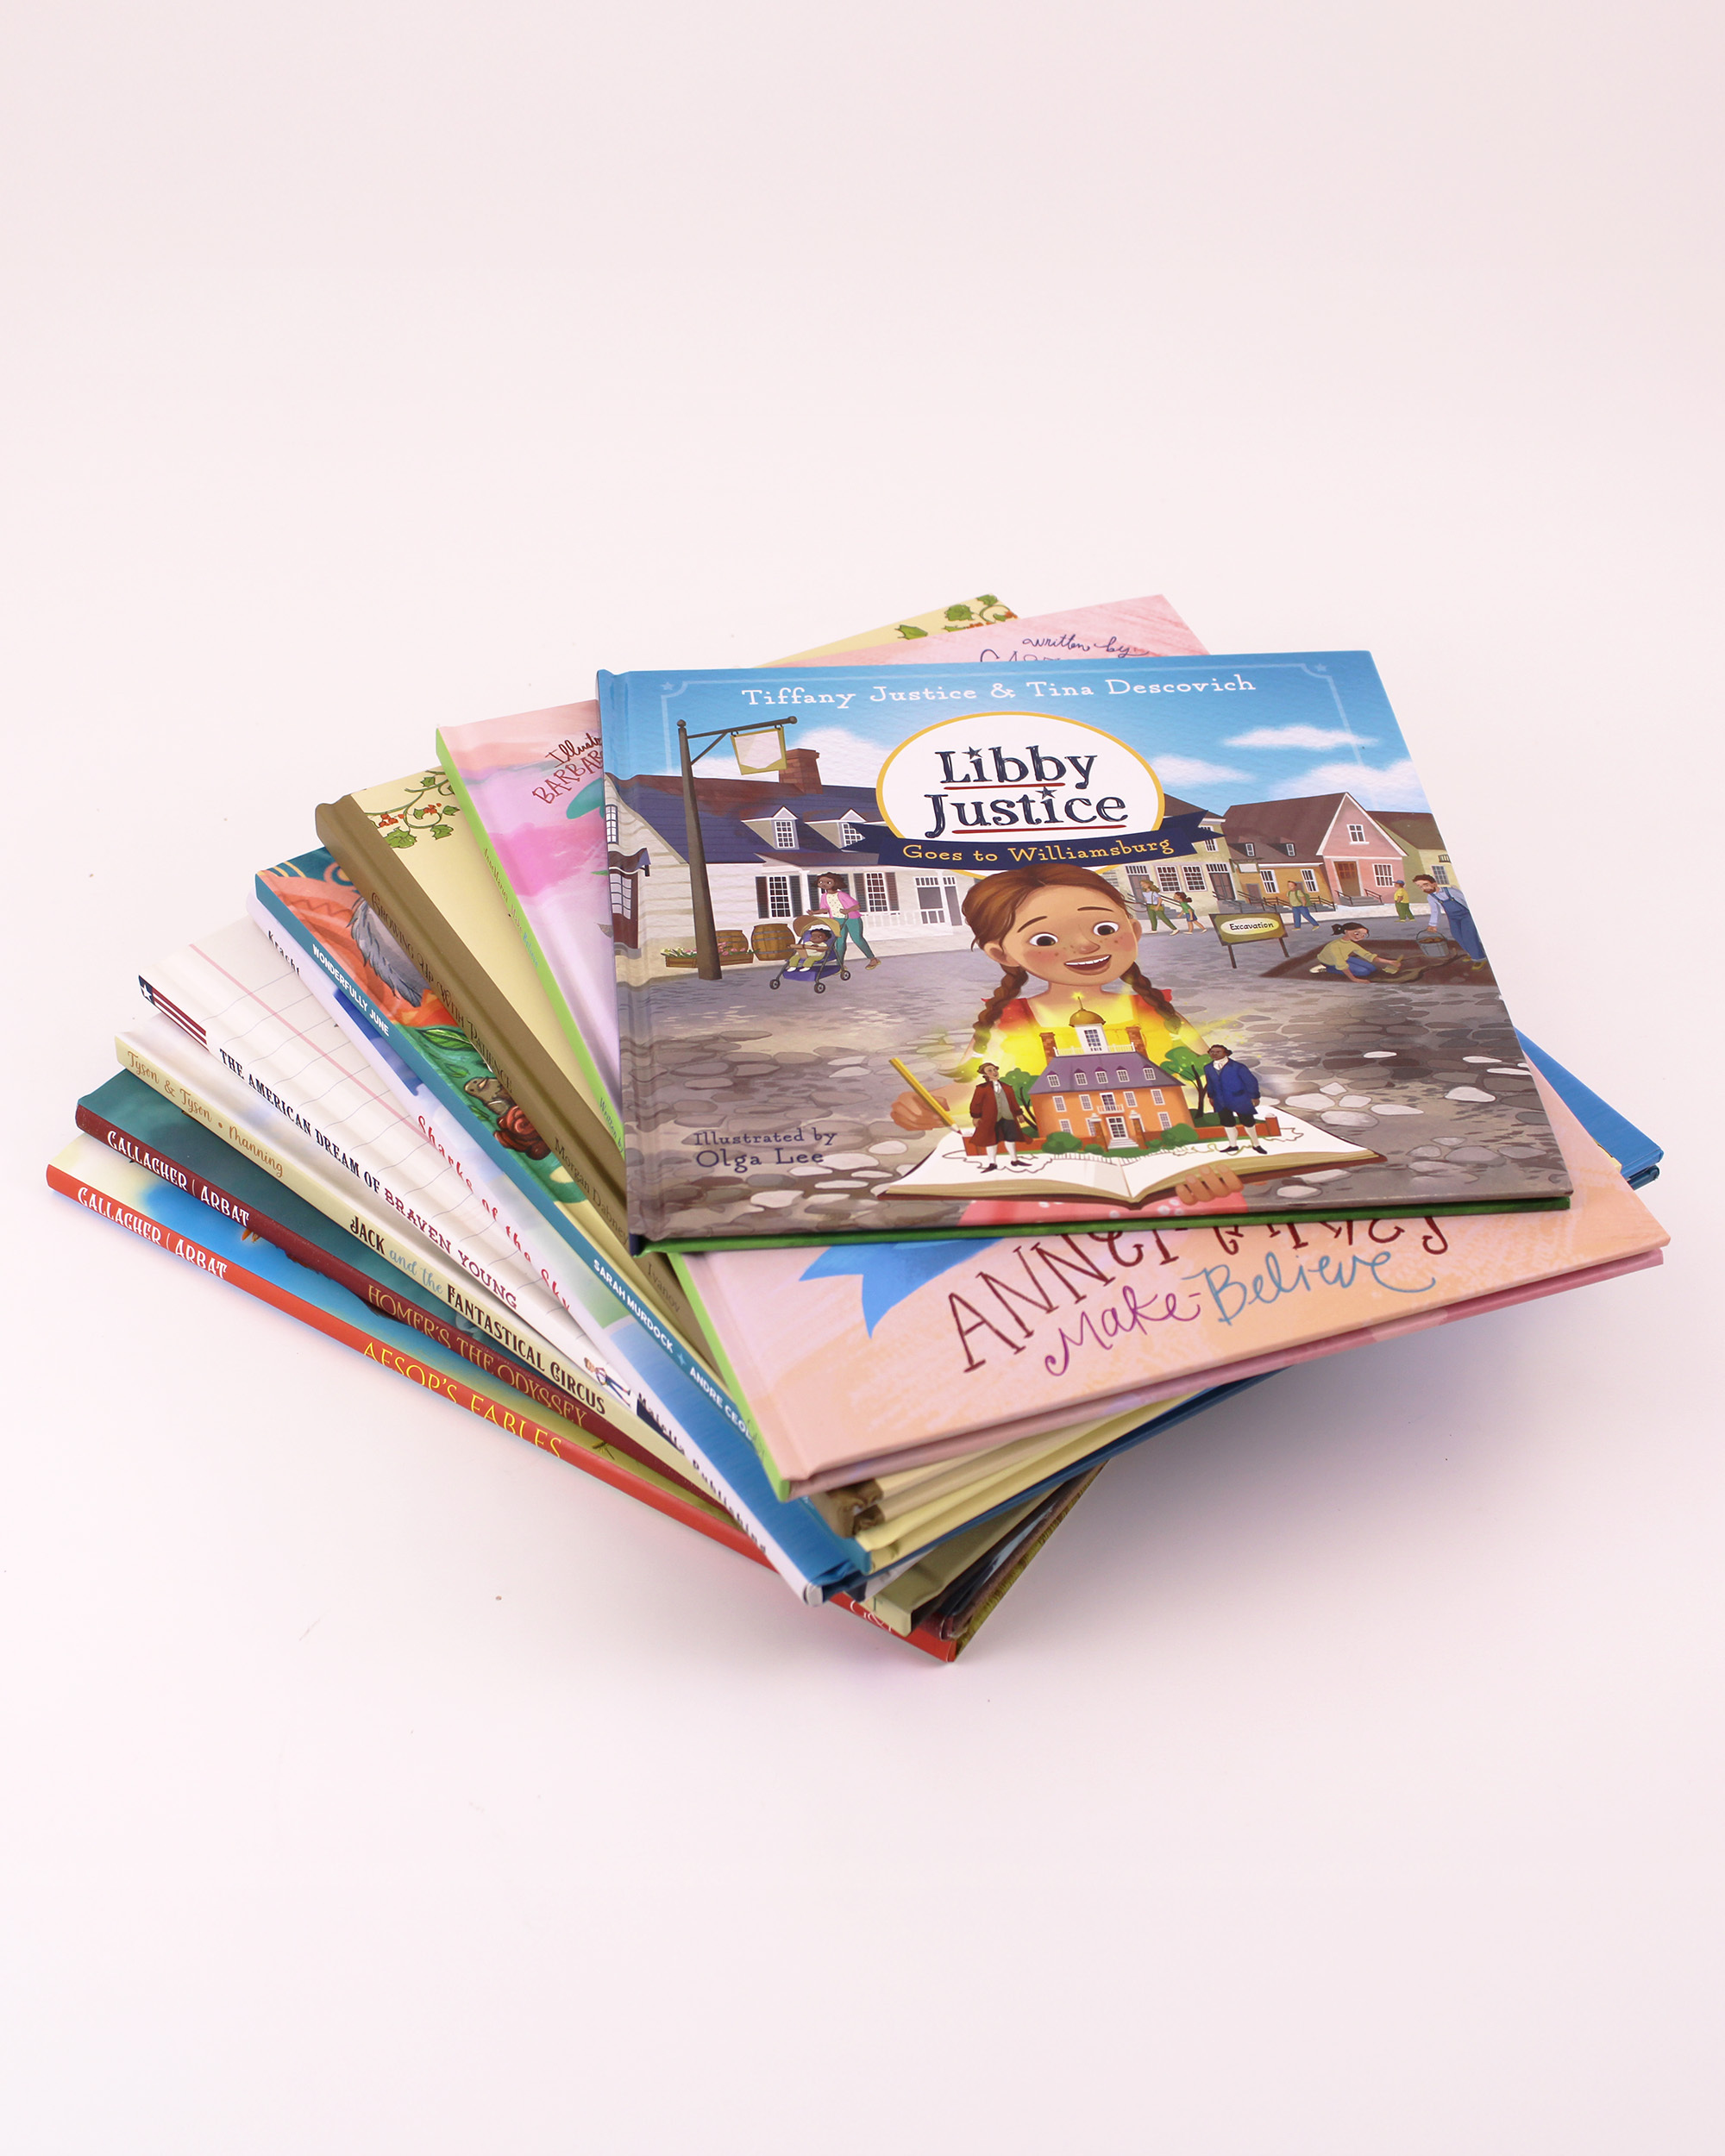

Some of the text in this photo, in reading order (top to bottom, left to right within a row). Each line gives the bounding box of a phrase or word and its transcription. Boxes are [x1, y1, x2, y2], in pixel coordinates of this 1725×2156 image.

[1022, 634, 1091, 652] written
[742, 674, 1257, 709] Tiffany Justice & Tina Descovich
[532, 749, 603, 804] BARBAR
[924, 787, 1128, 838] Justice
[934, 745, 1098, 789] Libby
[903, 839, 1175, 862] Goes to Williamsburg
[371, 892, 414, 959] GROWING
[417, 952, 434, 983] UP
[1229, 921, 1275, 931] Excavation
[312, 943, 389, 1037] WONDERFULLY JUNE
[127, 1050, 284, 1178] Tyson & Tyson Manning
[693, 1127, 837, 1146] Illustrated by
[107, 1131, 249, 1226] GALLAGHER ARBAT
[219, 1048, 518, 1310] THE AMERICAN DREAM OF BRAVEN YOUNG
[555, 1137, 628, 1245] Morgan Dabney
[696, 1147, 825, 1174] Olga Lee
[78, 1187, 228, 1279] GALLAGHER ARBAT
[350, 1215, 606, 1415] JACK and the FANTASTICAL CIRCUS
[647, 1263, 681, 1313] Ivanov
[367, 1284, 587, 1427] HOMER'S THE ODYSSEY
[593, 1259, 626, 1301] SARAH
[626, 1294, 674, 1353] MURDOCK
[690, 1367, 724, 1409] ANDRE
[363, 1342, 561, 1458] AESOP'S FABLES
